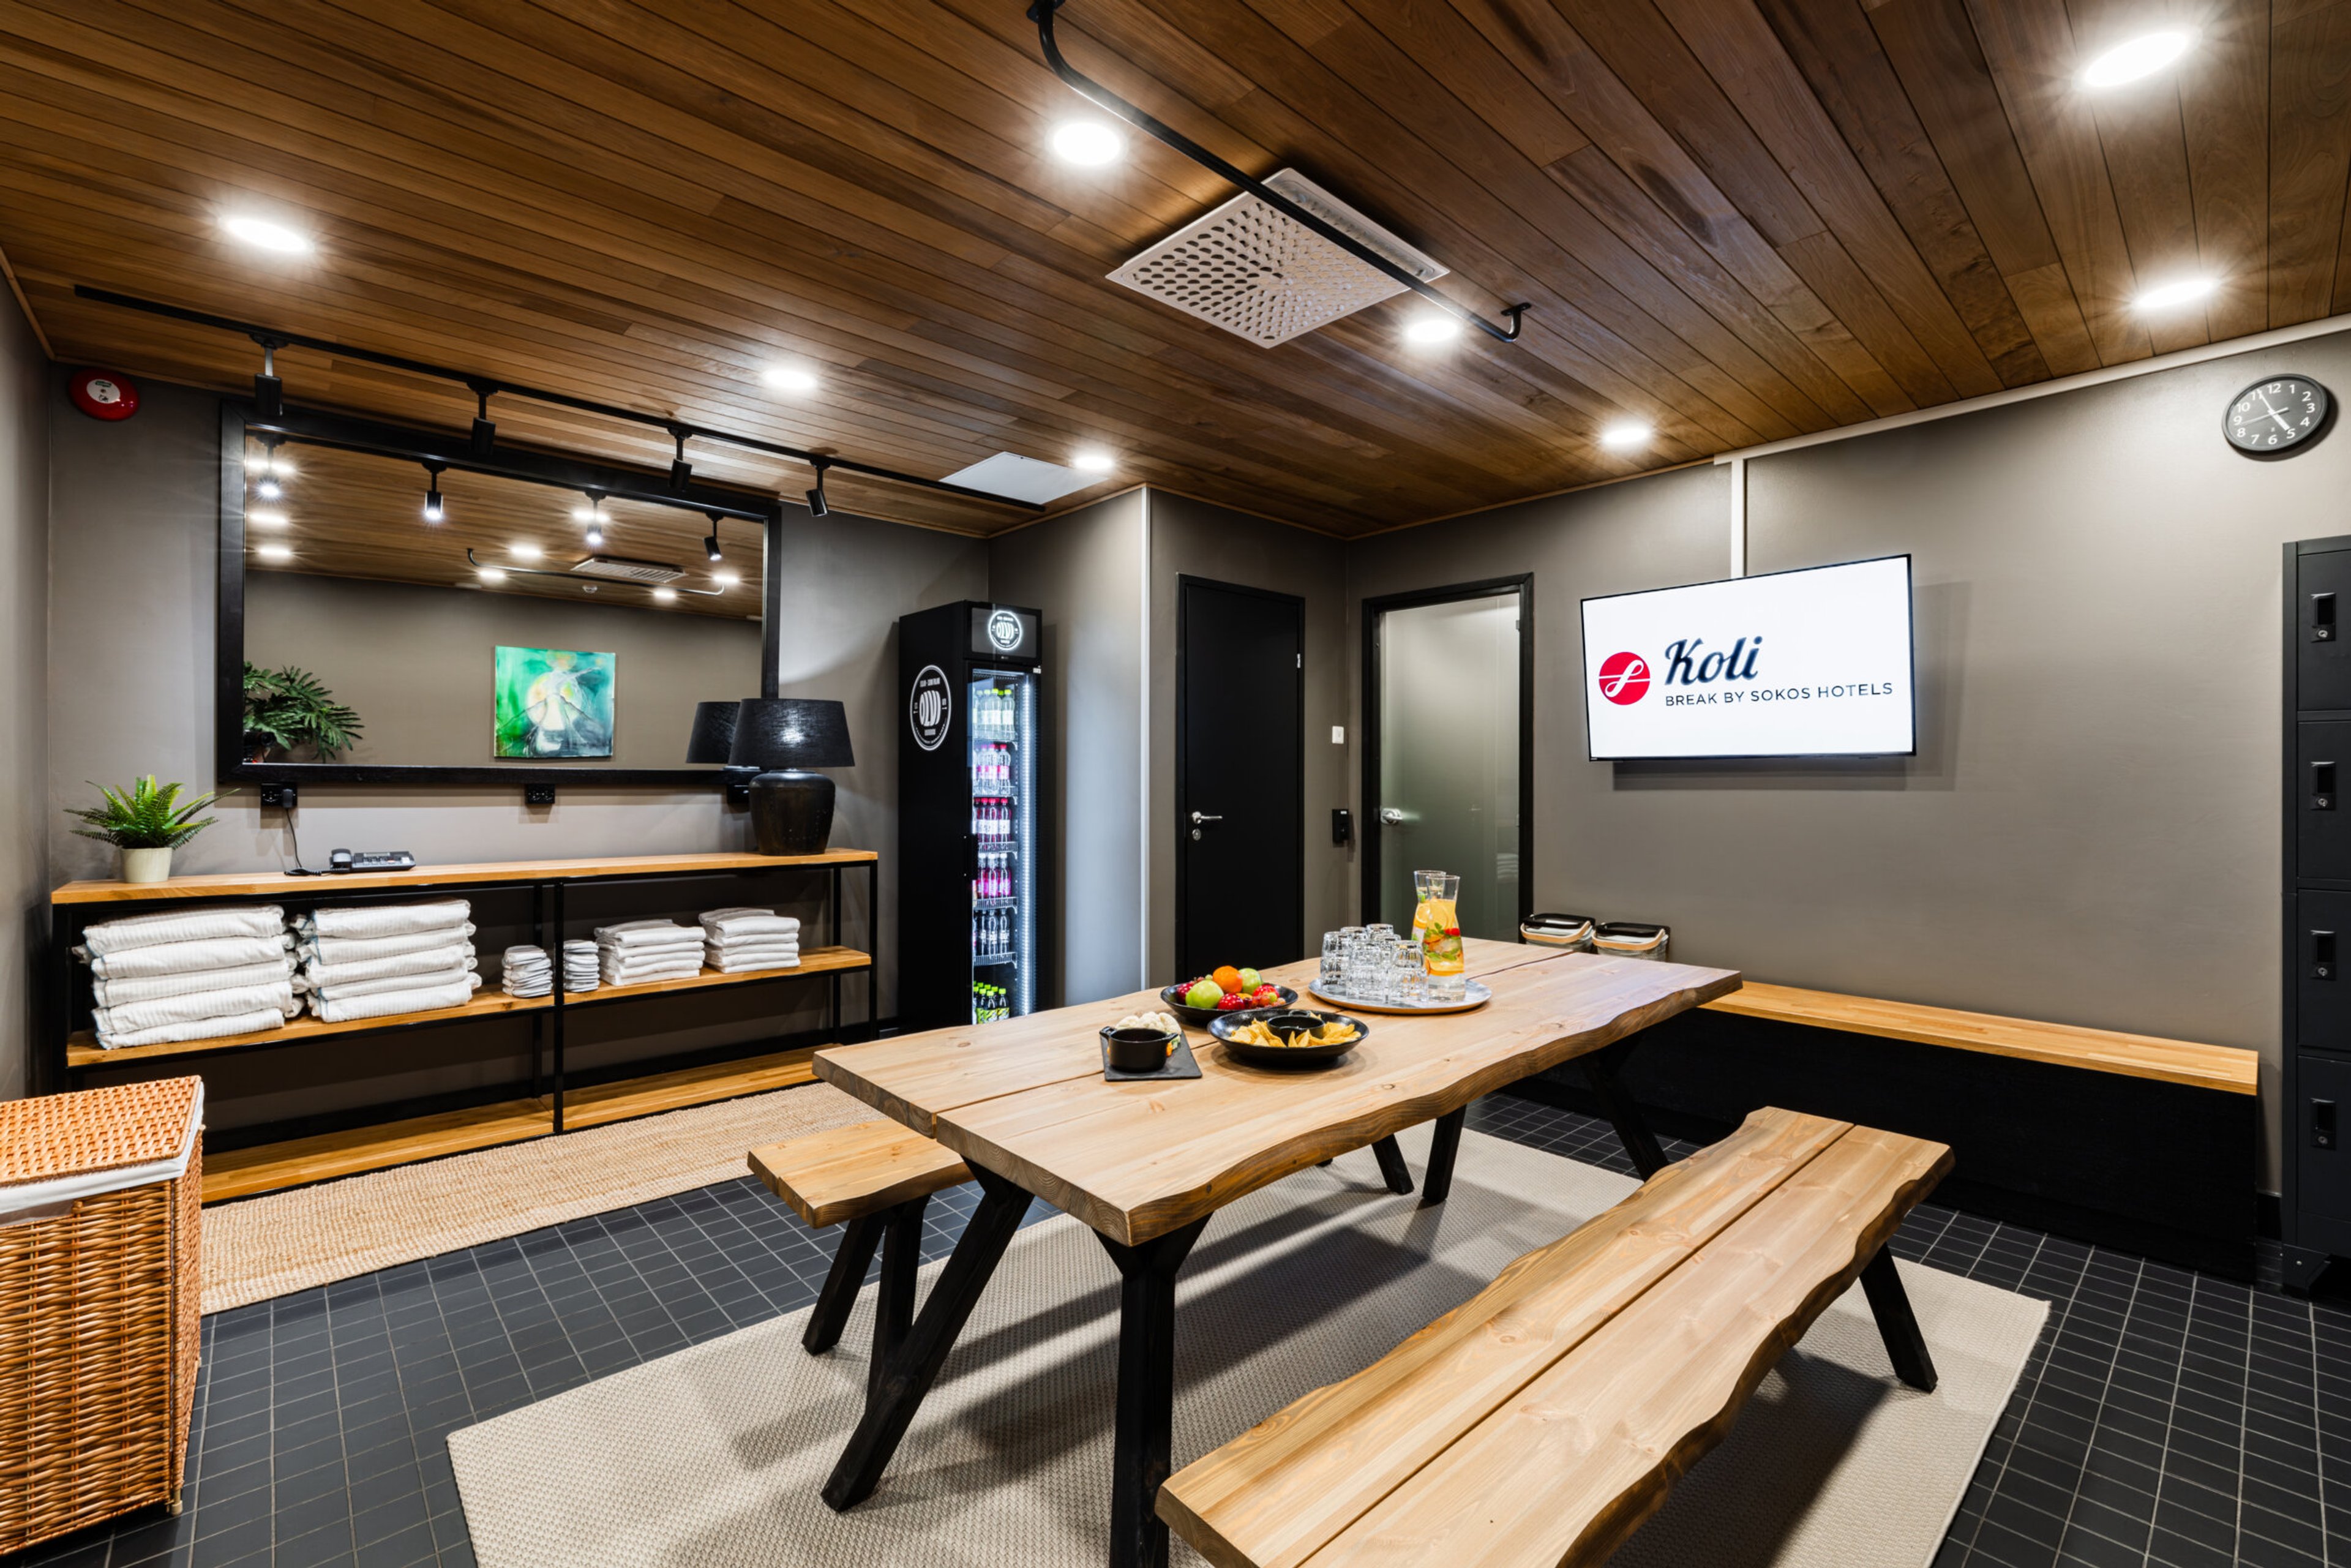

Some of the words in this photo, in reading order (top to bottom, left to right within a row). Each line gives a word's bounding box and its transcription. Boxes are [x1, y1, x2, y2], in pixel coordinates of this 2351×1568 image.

[2267, 383, 2281, 394] 12
[2289, 384, 2295, 394] 1
[2302, 391, 2311, 402] 2
[2237, 402, 2251, 413] 10
[2306, 402, 2315, 413] 3
[2233, 415, 2242, 426] 9
[2300, 416, 2310, 427] 4
[2237, 427, 2246, 438] 8
[2286, 428, 2295, 439] 5
[2251, 433, 2260, 445] 7
[2268, 434, 2278, 445] 6
[1665, 636, 1763, 686] Koli
[1665, 692, 1717, 707] BREAK
[1723, 691, 1745, 703] BY
[1750, 688, 1810, 702] SOKOS
[1818, 682, 1893, 698] HOTELS
